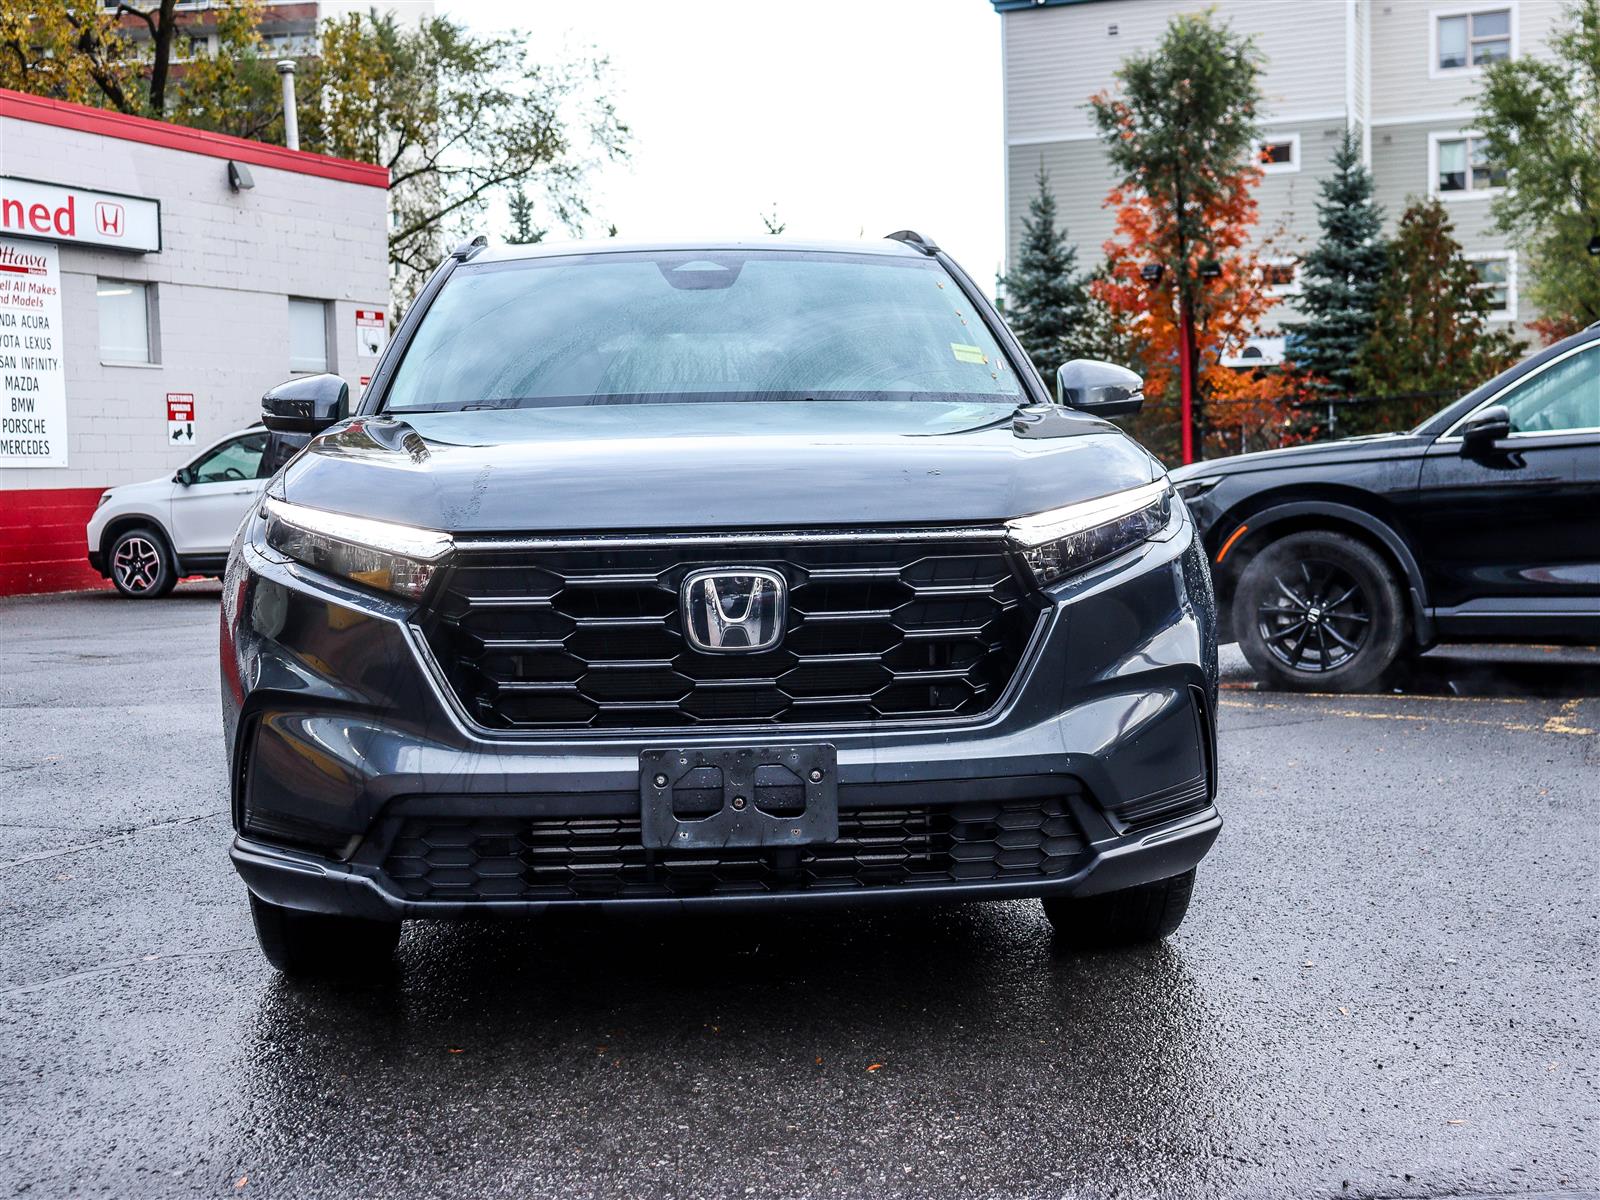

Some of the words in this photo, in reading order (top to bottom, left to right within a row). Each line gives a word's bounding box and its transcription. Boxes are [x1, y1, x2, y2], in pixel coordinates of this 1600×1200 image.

[2, 196, 76, 237] ned
[0, 245, 47, 268] ttawa
[13, 281, 26, 293] All
[28, 282, 57, 296] Makes
[11, 294, 44, 308] Models
[21, 314, 50, 330] ACURA
[24, 335, 52, 351] LEXUS
[21, 356, 58, 372] INFINITY
[5, 375, 40, 392] MAZDA
[11, 397, 35, 413] BMW
[2, 418, 47, 434] PORSCHE
[0, 439, 50, 455] MERCEDES
